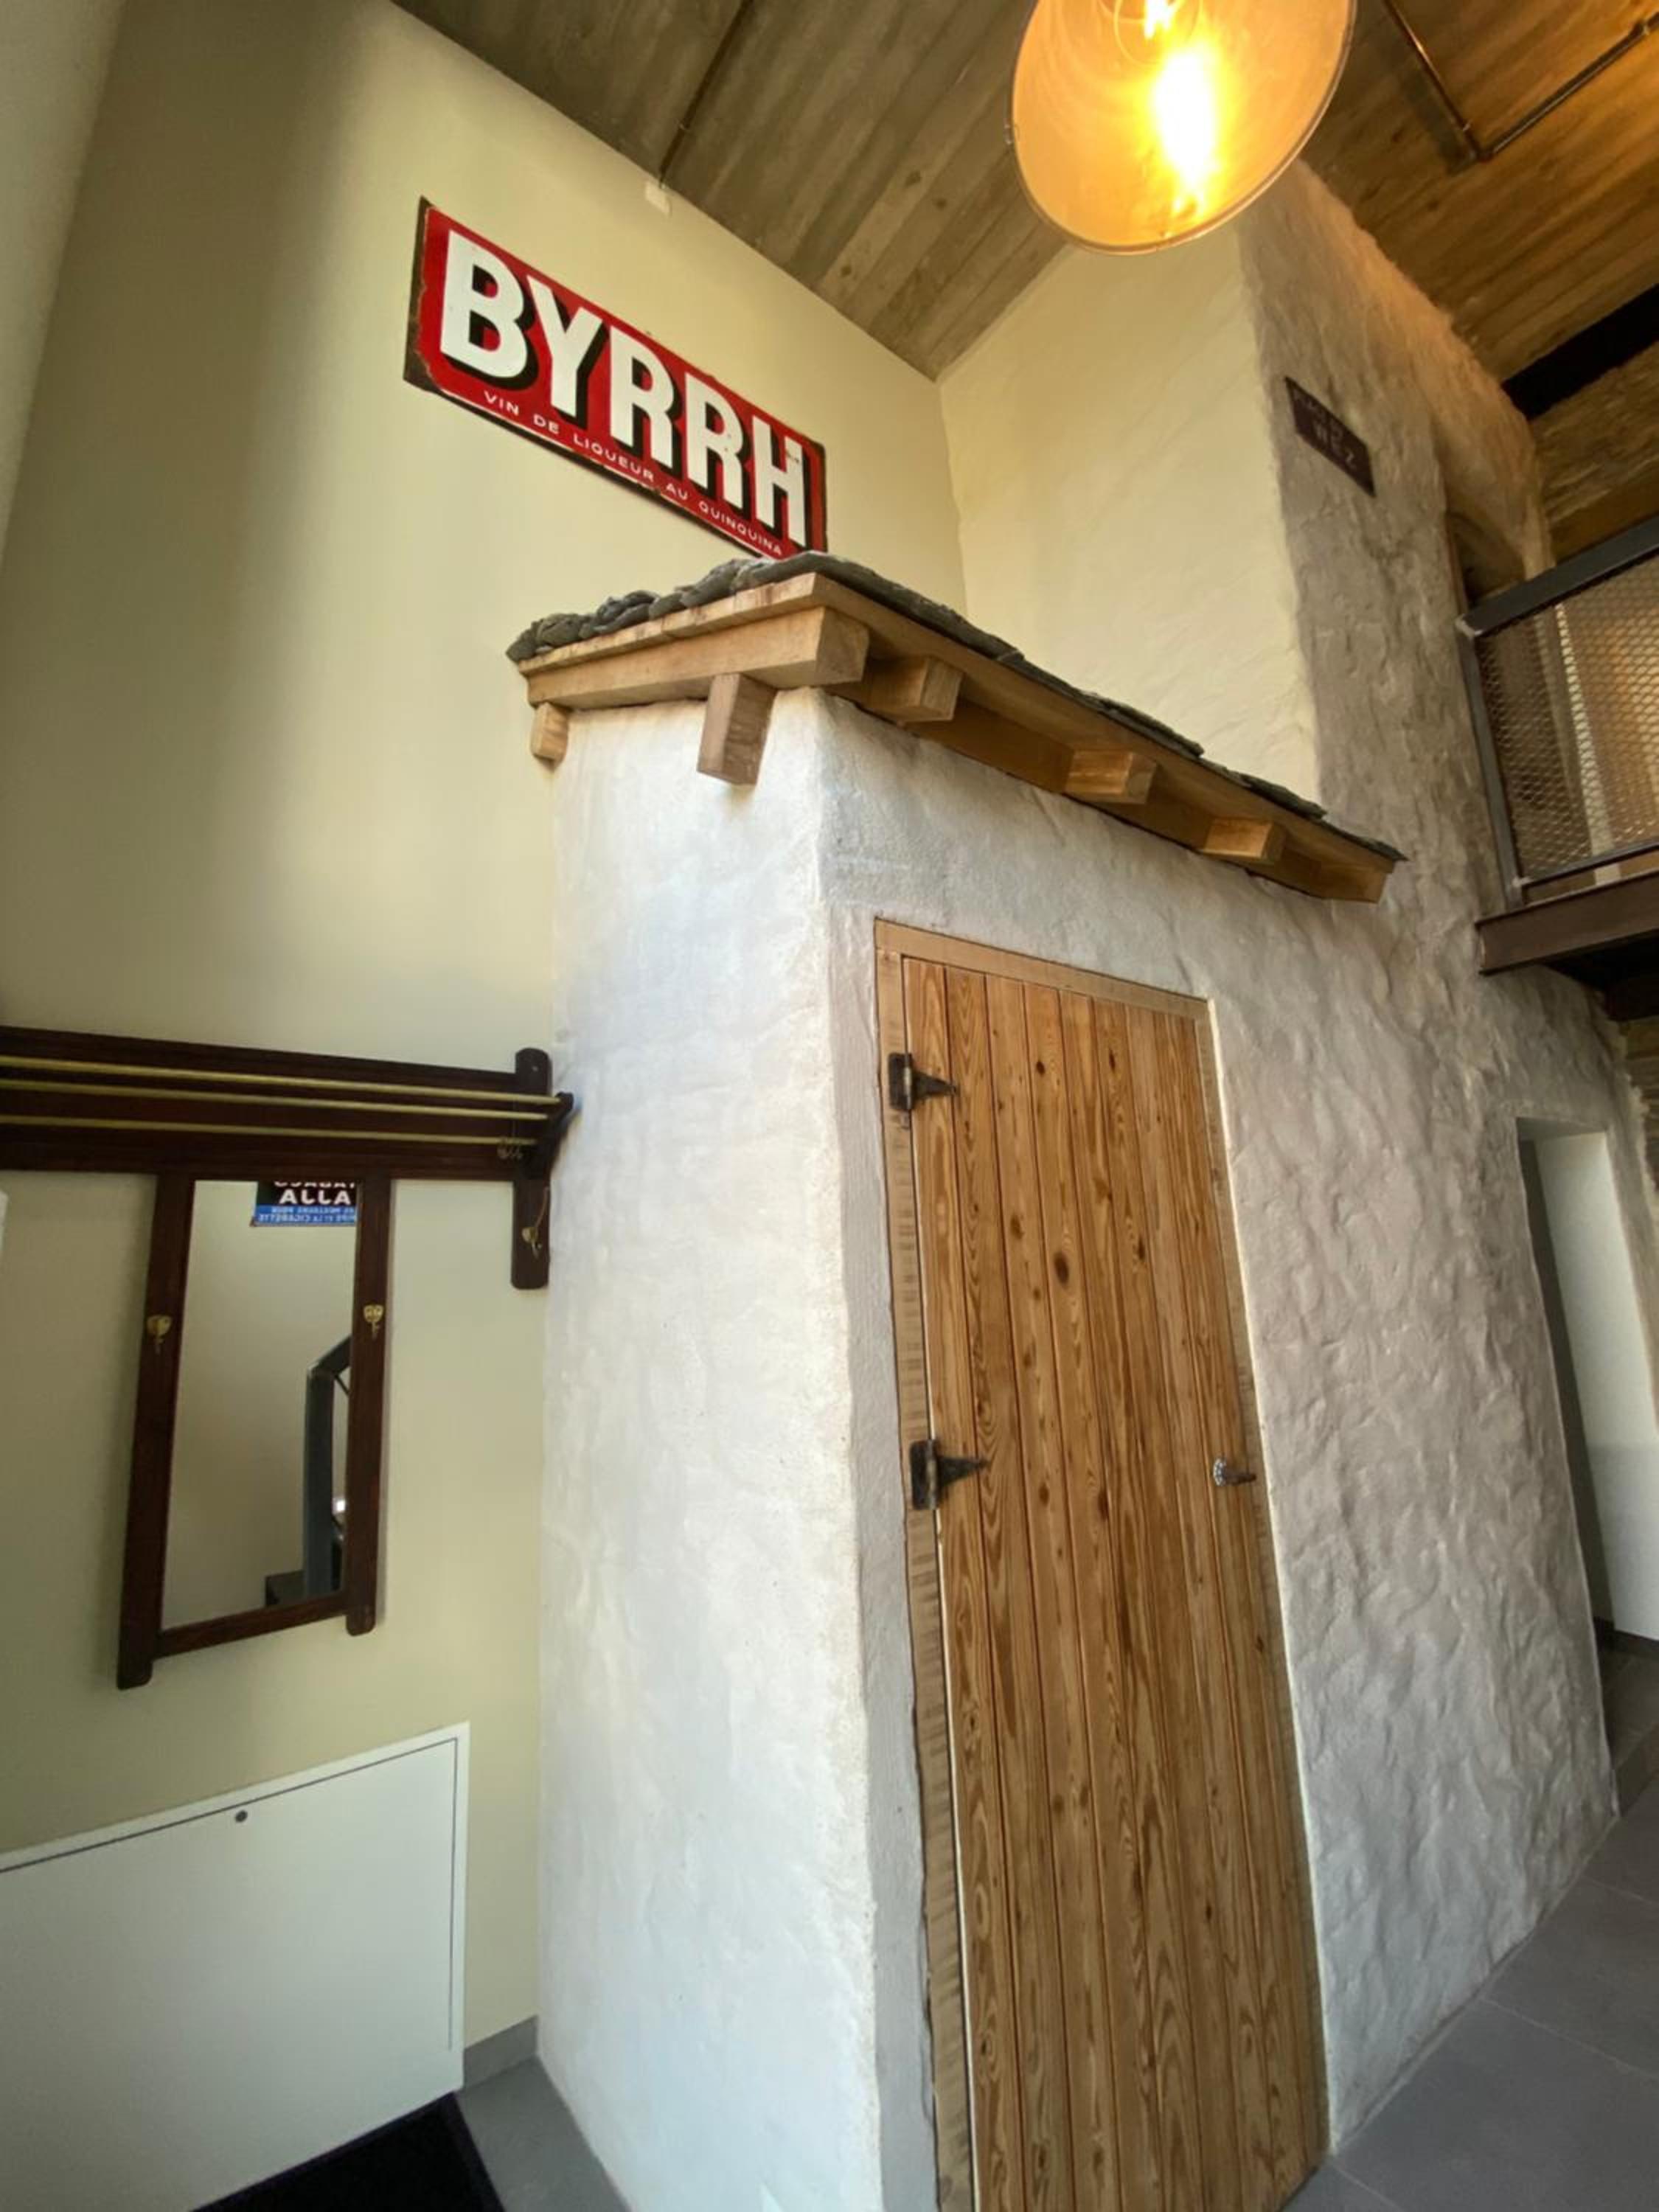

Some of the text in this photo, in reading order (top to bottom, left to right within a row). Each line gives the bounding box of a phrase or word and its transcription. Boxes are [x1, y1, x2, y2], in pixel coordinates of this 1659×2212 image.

[439, 229, 807, 548] BYRRH
[484, 390, 782, 555] VIN DE LIQUEUR AU QUINQUINA
